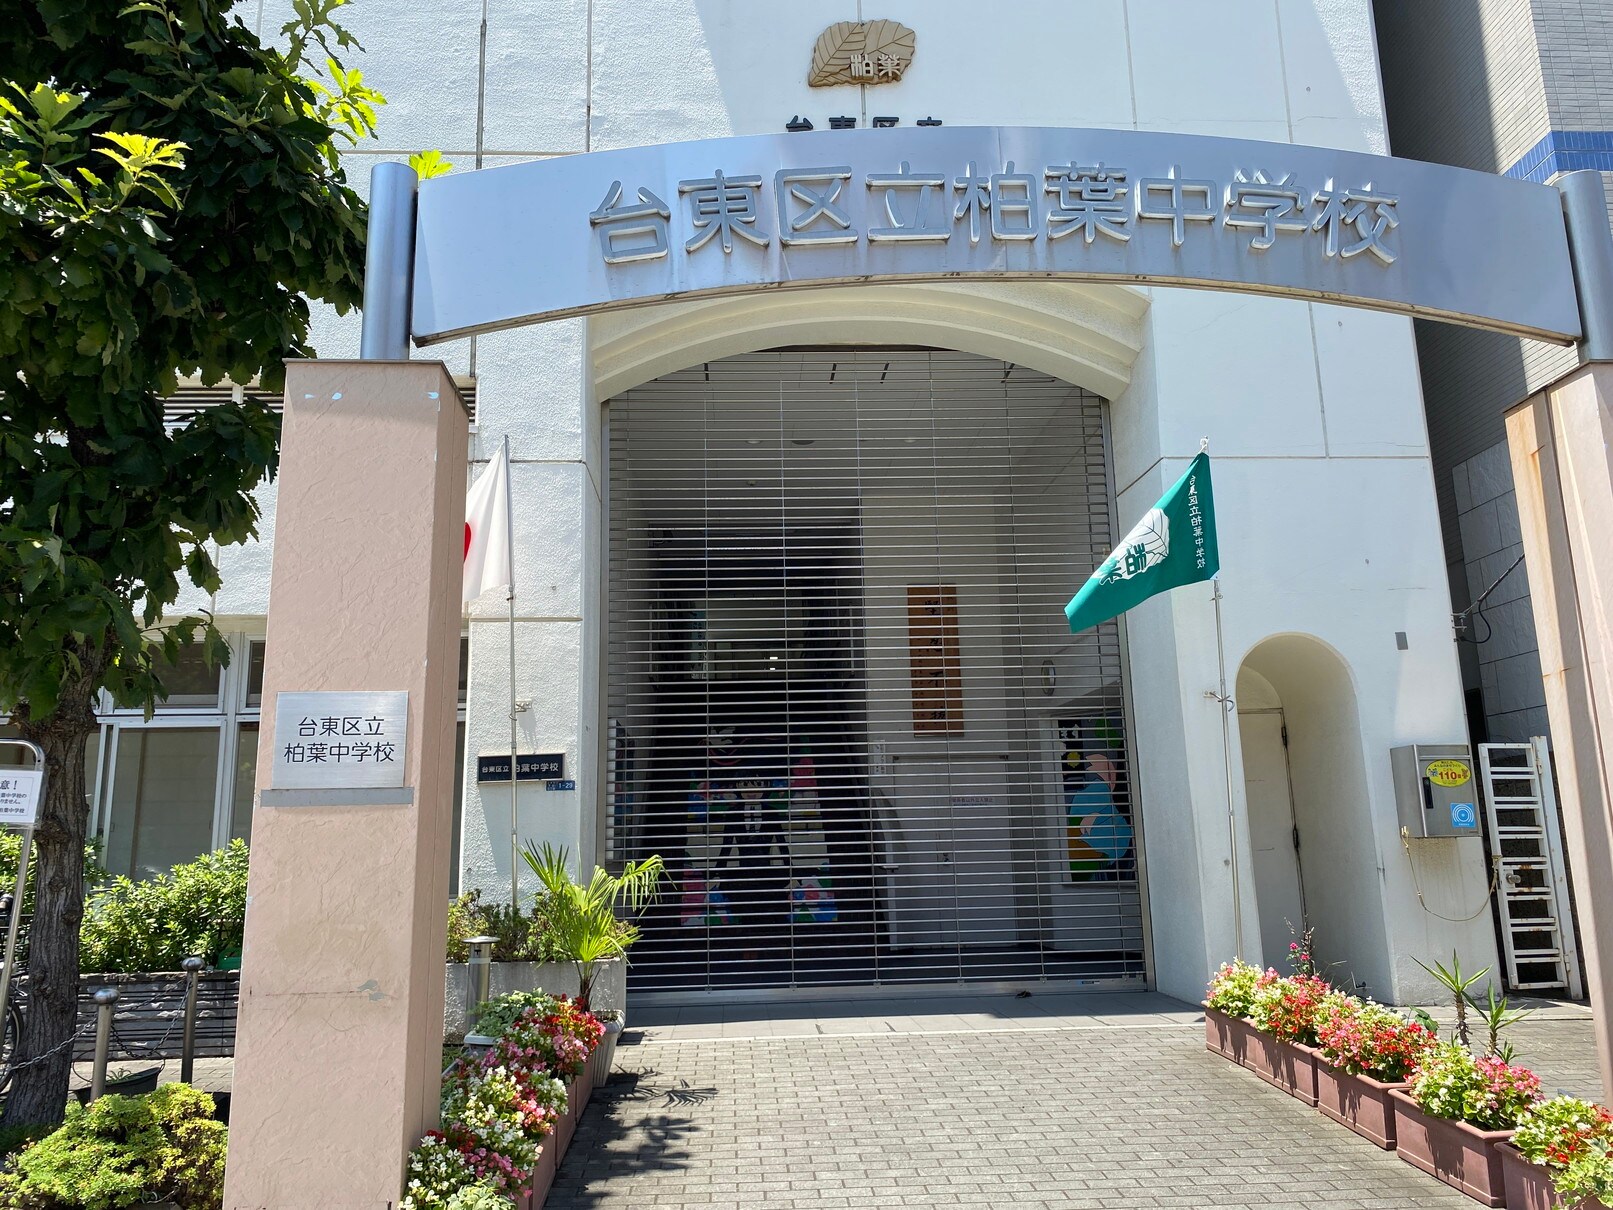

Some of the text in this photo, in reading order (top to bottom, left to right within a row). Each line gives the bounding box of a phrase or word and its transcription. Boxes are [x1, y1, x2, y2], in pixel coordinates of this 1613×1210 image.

[589, 160, 1399, 264] 台東区立柏葉中学校
[298, 715, 385, 737] 台東区立
[283, 741, 395, 763] 柏葉中学校
[481, 765, 510, 773] 台東区立
